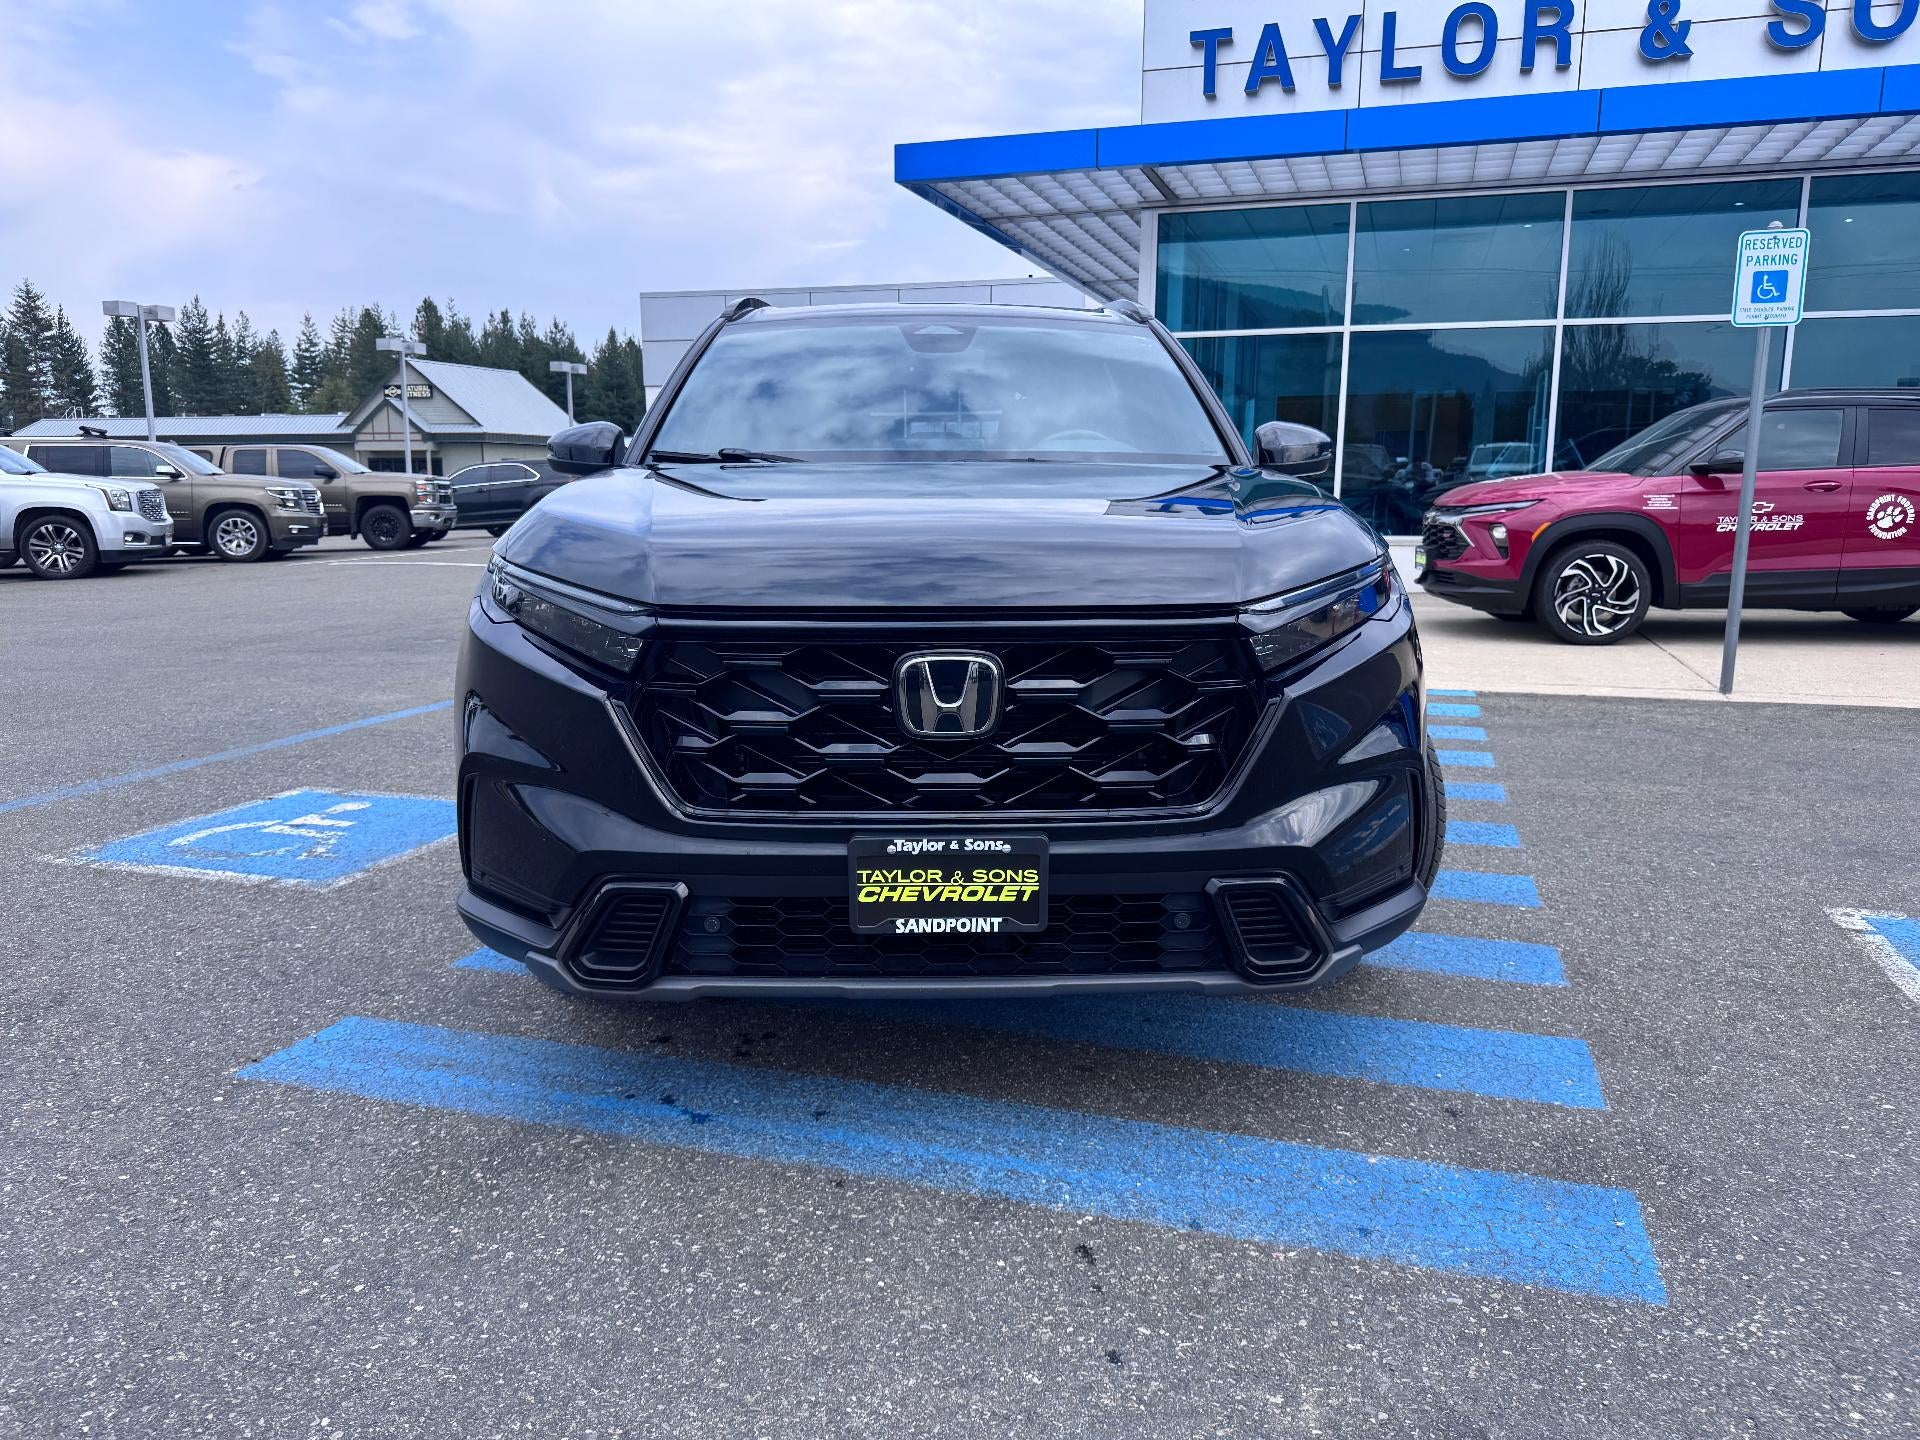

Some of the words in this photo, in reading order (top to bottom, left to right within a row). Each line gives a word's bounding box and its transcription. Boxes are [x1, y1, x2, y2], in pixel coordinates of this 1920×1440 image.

[1190, 0, 1575, 96] TAYLOR
[1639, 0, 1694, 60] &
[1745, 236, 1803, 251] RESERVED
[1746, 253, 1798, 267] PARKING
[1866, 494, 1895, 521] SANDPOINT
[1897, 495, 1916, 524] FOOTBALL
[1716, 522, 1804, 532] CHVROLET
[1760, 515, 1768, 524] &
[1772, 514, 1804, 522] SONS
[1868, 523, 1908, 540] FOUNDATION
[893, 838, 945, 855] Taylor
[949, 840, 960, 850] &
[963, 838, 1004, 852] Sons
[856, 869, 943, 883] TAYLOR
[950, 870, 965, 886] &
[972, 869, 1040, 883] SONS
[857, 885, 1040, 903] CHEVROLET
[895, 917, 1003, 934] SANDPOINT
